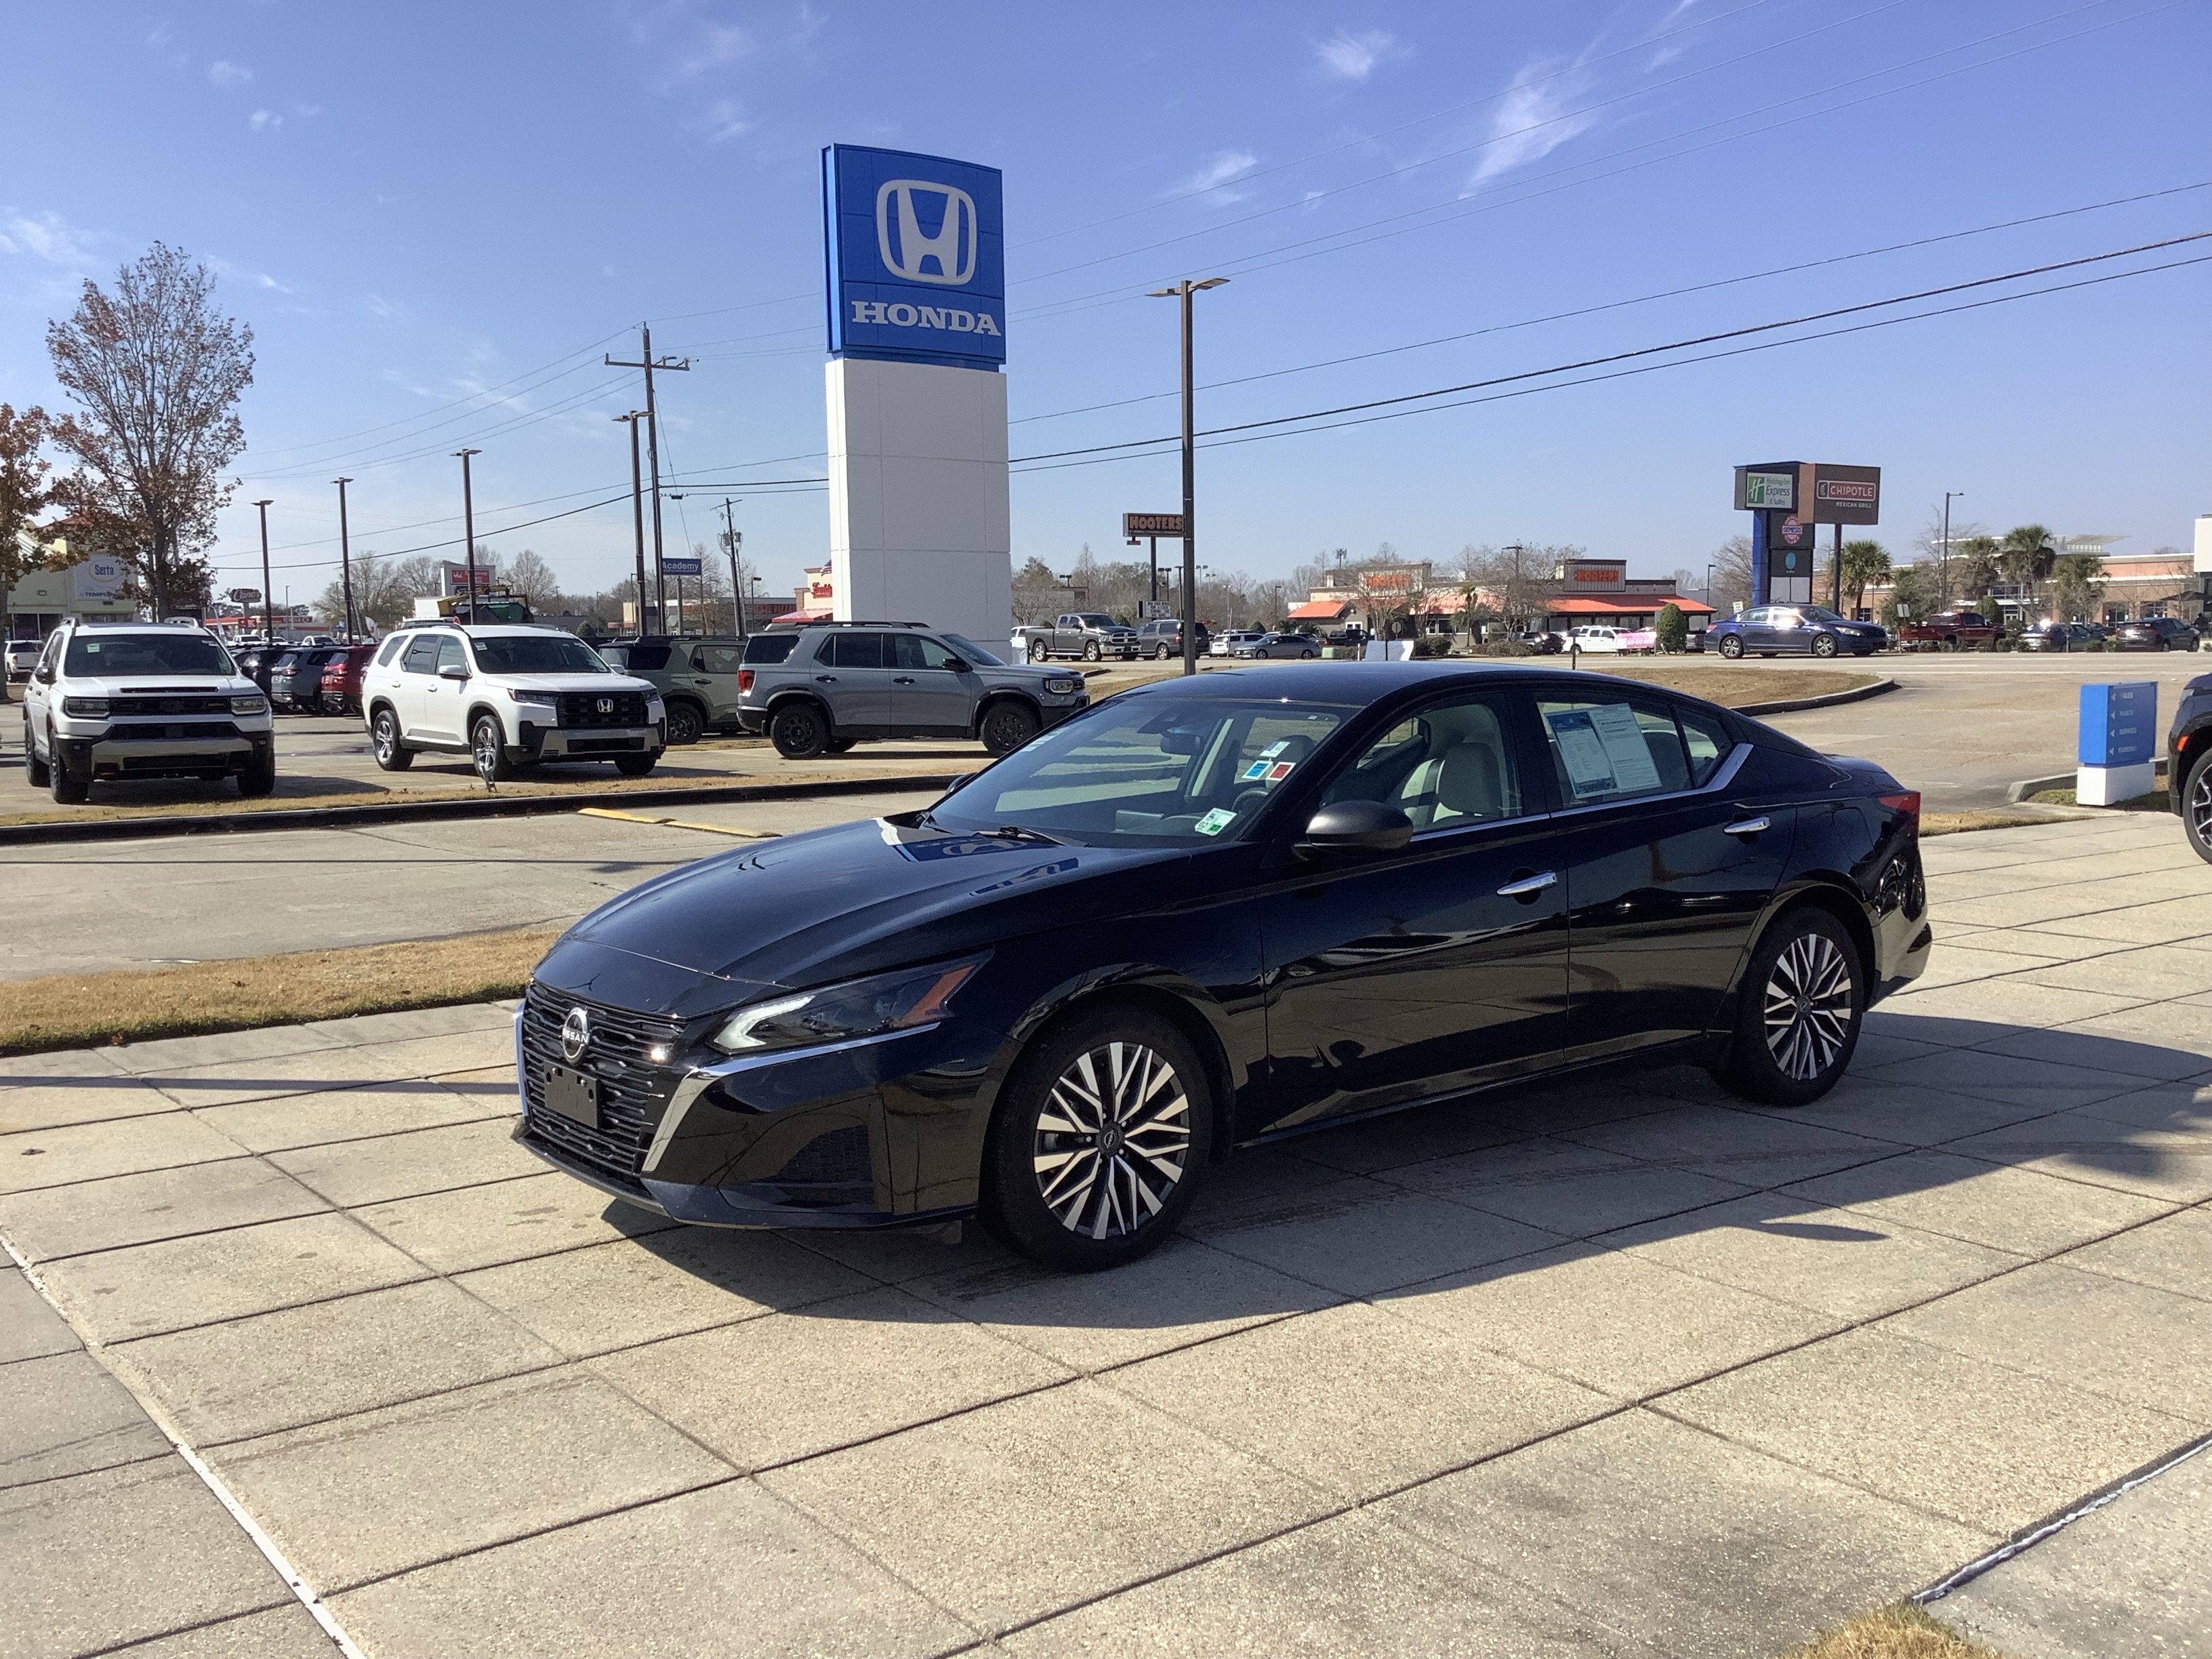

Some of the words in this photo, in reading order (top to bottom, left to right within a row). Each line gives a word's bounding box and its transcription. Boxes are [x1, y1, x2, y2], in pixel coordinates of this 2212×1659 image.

[851, 300, 1002, 337] HONDA
[1765, 485, 1790, 498] Express
[1830, 485, 1873, 497] CHIPOTLE
[1129, 516, 1183, 530] HOOTERS
[95, 565, 114, 575] Serta
[662, 561, 699, 572] Academy
[562, 1029, 590, 1044] SSAN
